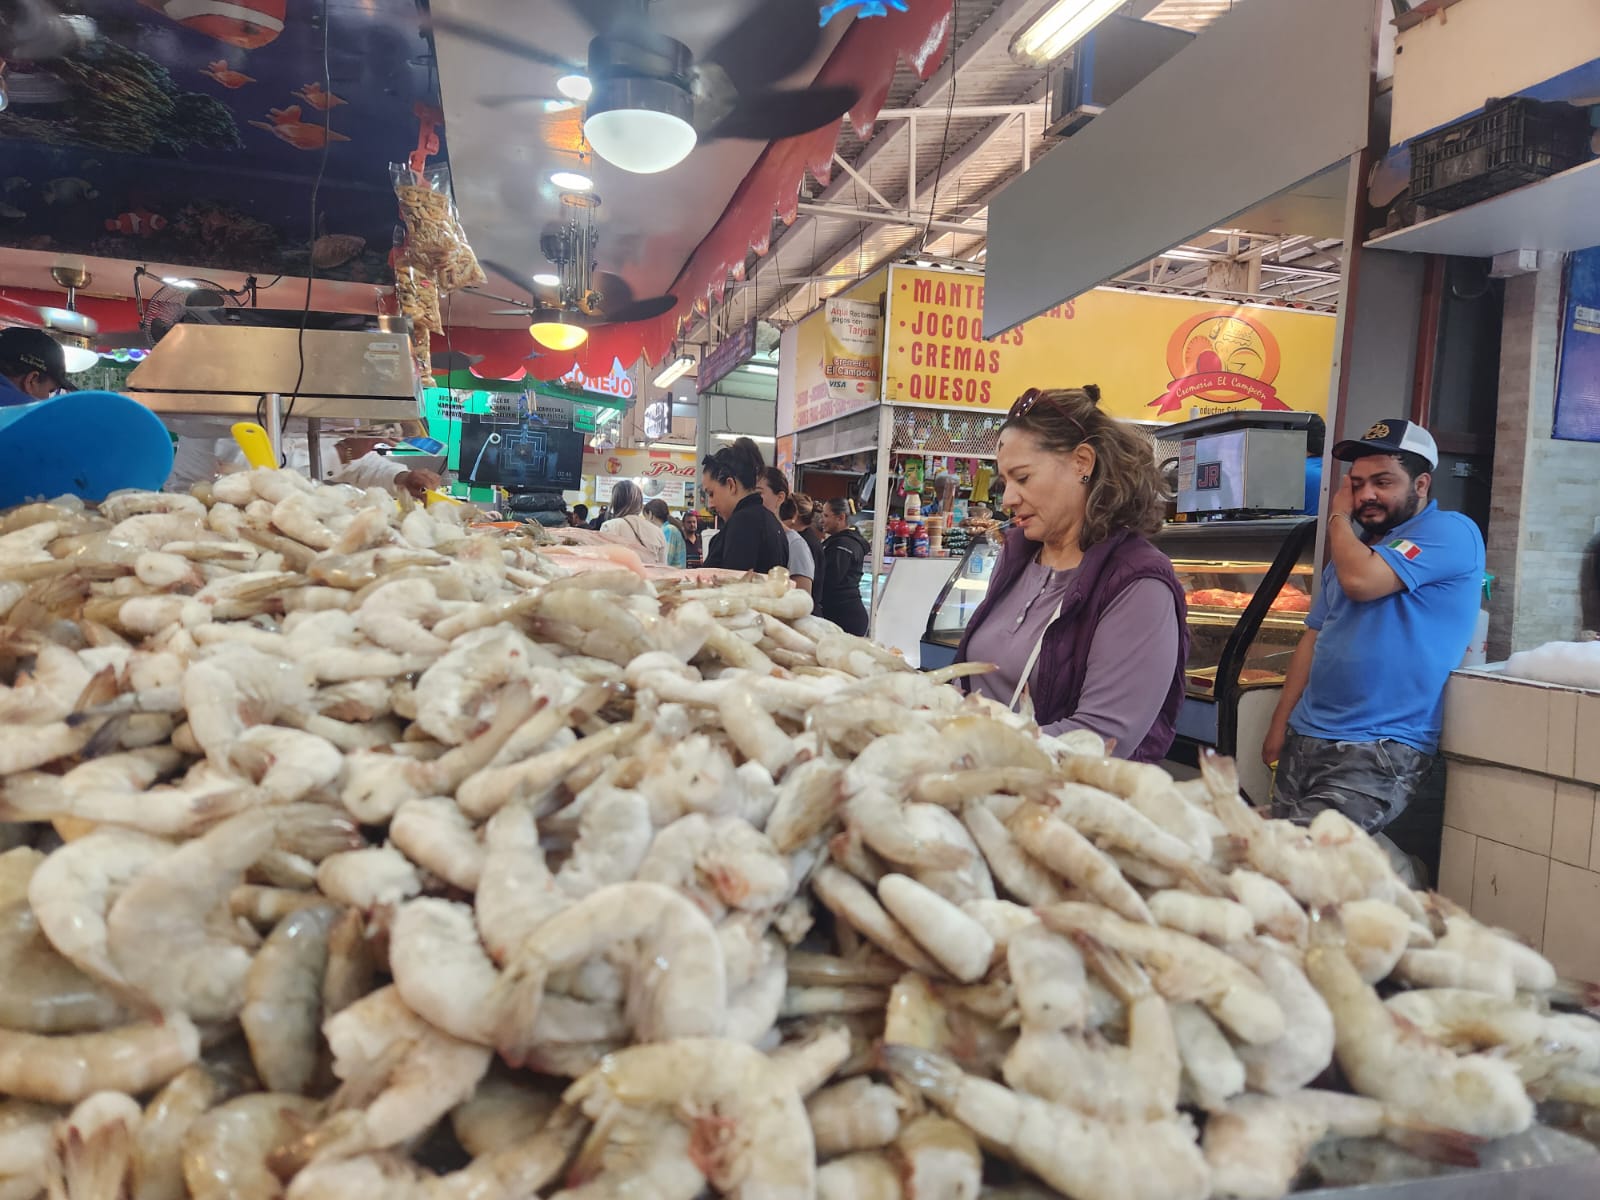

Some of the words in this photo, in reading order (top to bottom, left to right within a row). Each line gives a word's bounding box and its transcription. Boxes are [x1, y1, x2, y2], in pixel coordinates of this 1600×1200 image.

[914, 278, 1076, 320] MANTEAS
[832, 316, 850, 324] pagos
[848, 324, 877, 337] Tarjeta
[911, 311, 1025, 346] JOCOQES
[911, 341, 1000, 373] CREMAS
[826, 365, 836, 375] El
[1217, 376, 1226, 386] El
[910, 374, 991, 404] QUESOS
[1197, 465, 1219, 487] JR
